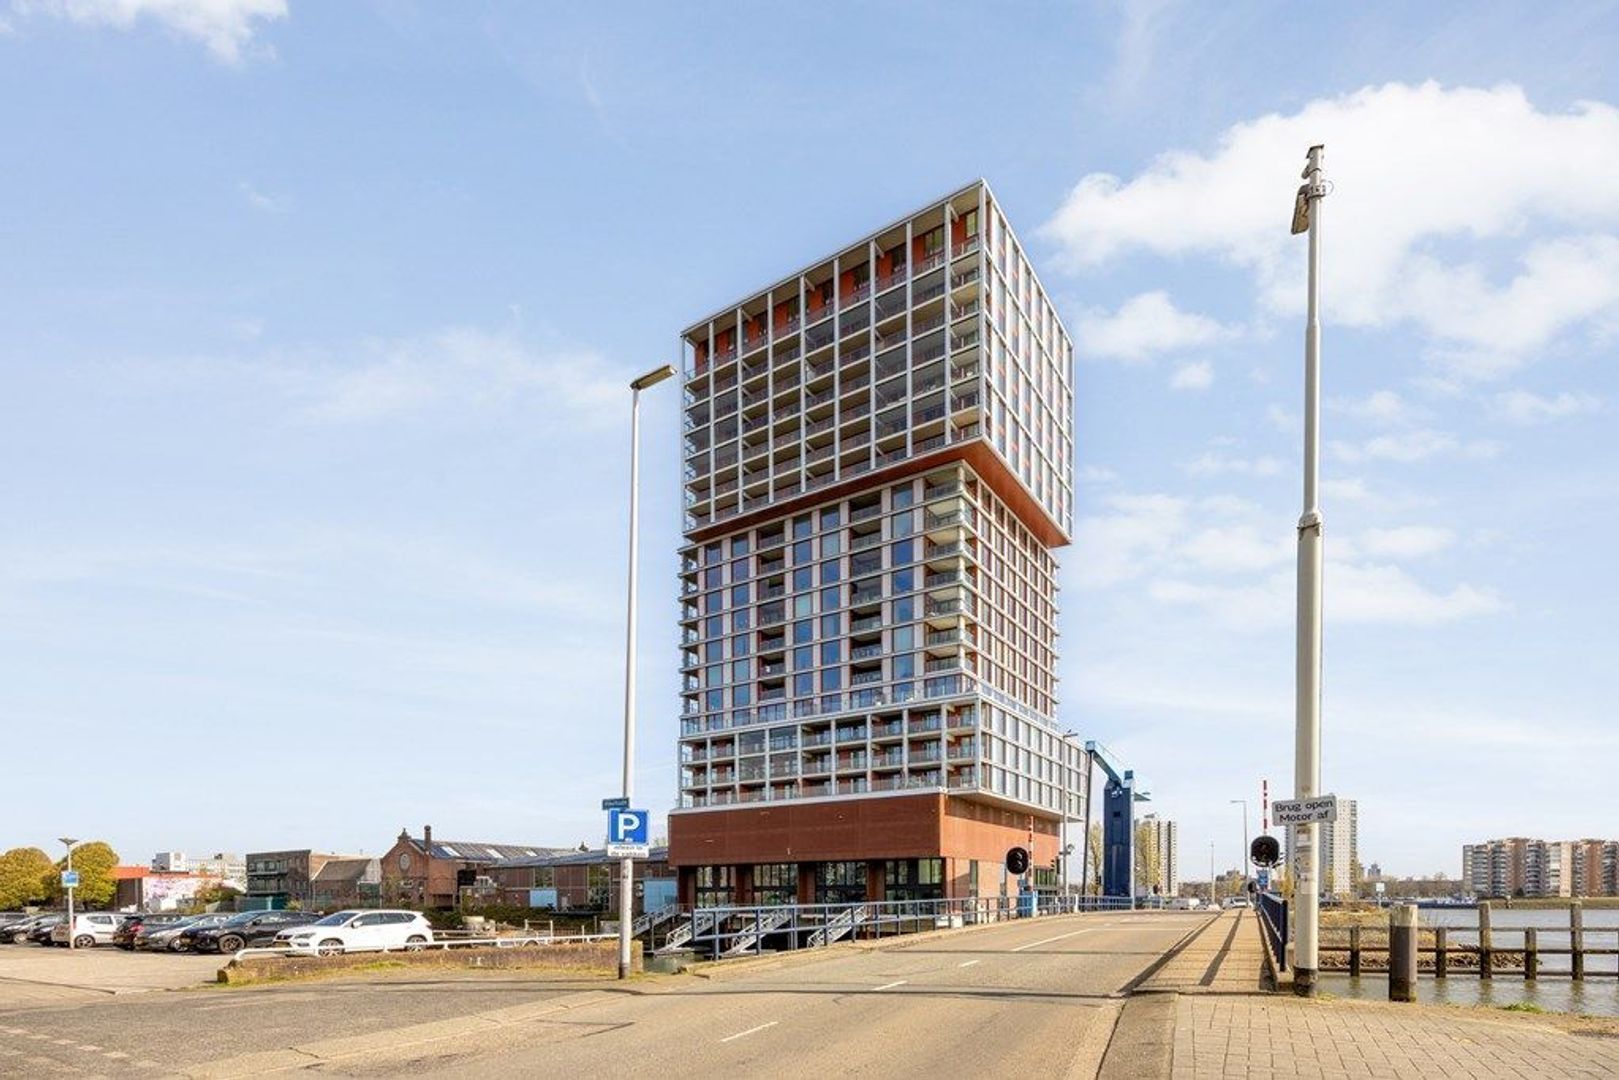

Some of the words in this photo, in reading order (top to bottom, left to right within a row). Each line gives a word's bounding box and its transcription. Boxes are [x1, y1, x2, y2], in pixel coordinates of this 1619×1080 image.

[1275, 803, 1301, 812] Brug
[1305, 800, 1333, 810] open
[1279, 812, 1313, 822] Motor
[1317, 809, 1329, 819] af
[618, 813, 640, 840] P
